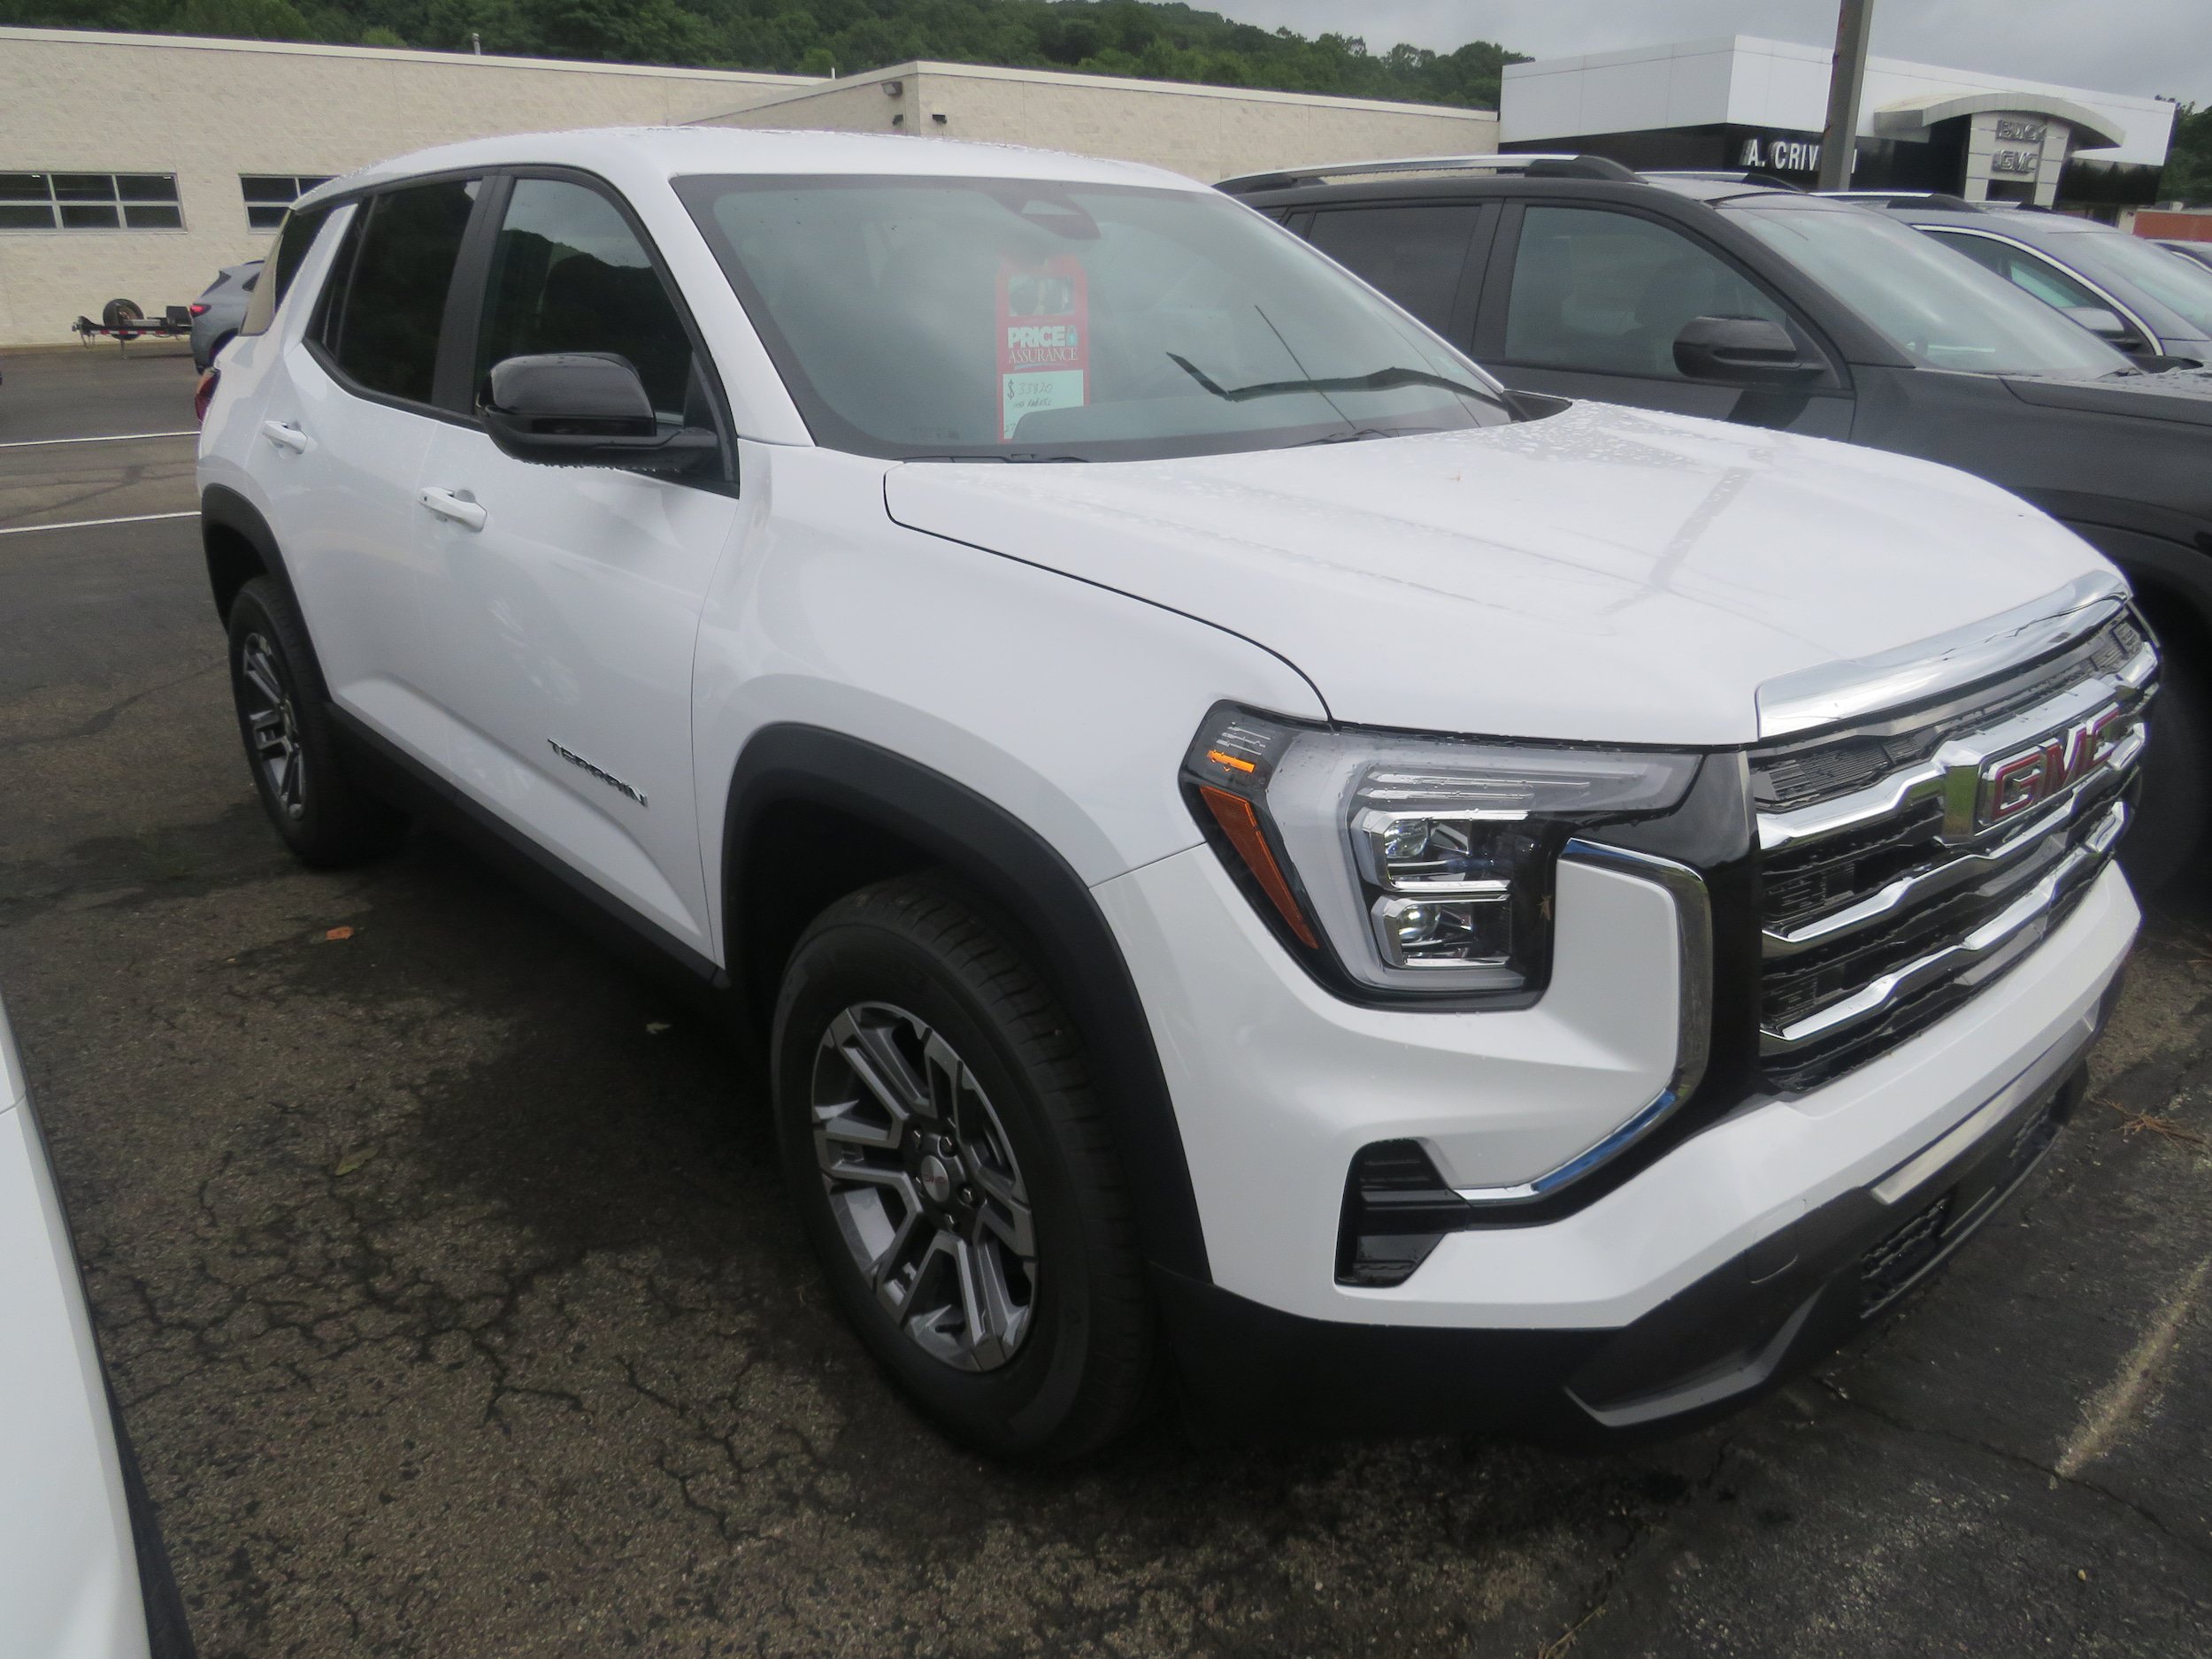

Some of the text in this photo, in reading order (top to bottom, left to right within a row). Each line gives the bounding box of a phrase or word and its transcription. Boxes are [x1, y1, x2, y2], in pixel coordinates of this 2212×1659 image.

[1993, 147, 2039, 173] GMC
[1008, 326, 1065, 348] PRICE
[1008, 346, 1078, 364] ASSURANCE
[547, 737, 649, 808] TERRAIN
[1979, 702, 2120, 825] GMC
